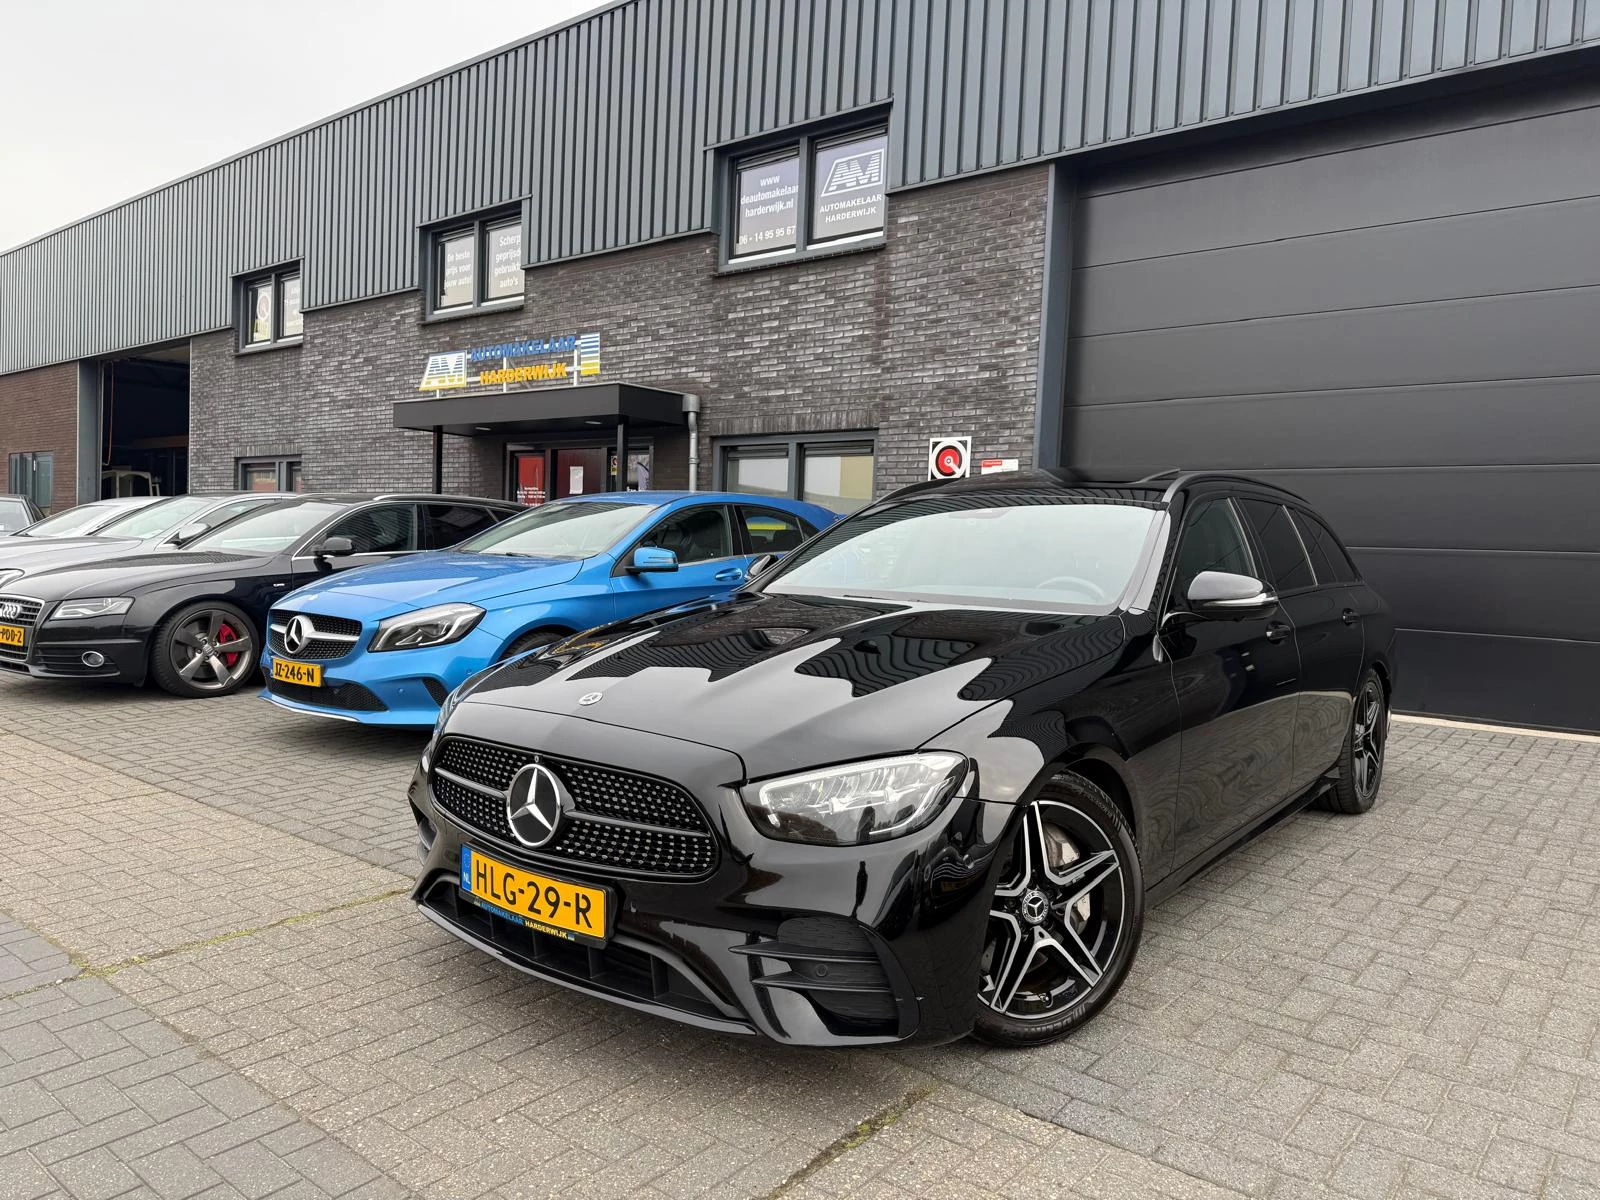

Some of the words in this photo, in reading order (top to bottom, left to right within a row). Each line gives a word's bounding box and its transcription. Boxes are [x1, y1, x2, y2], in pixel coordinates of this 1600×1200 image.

[760, 175, 780, 187] www
[740, 184, 799, 205] deautomakelaar
[820, 193, 882, 214] AUTOMAKELAAR
[745, 198, 794, 218] harderwijk.nl
[825, 206, 877, 223] HARDERWIJK
[755, 231, 763, 242] 14
[764, 229, 774, 240] 95
[775, 227, 785, 238] 95
[786, 225, 796, 235] 67
[470, 334, 577, 362] AUTOMAKELAAR
[479, 362, 568, 386] HARDERWIJK
[463, 872, 471, 885] NL
[475, 859, 593, 929] HLG-29-R
[480, 901, 524, 926] AUTOMAKELAAR
[524, 919, 569, 940] HARDERWIJK
